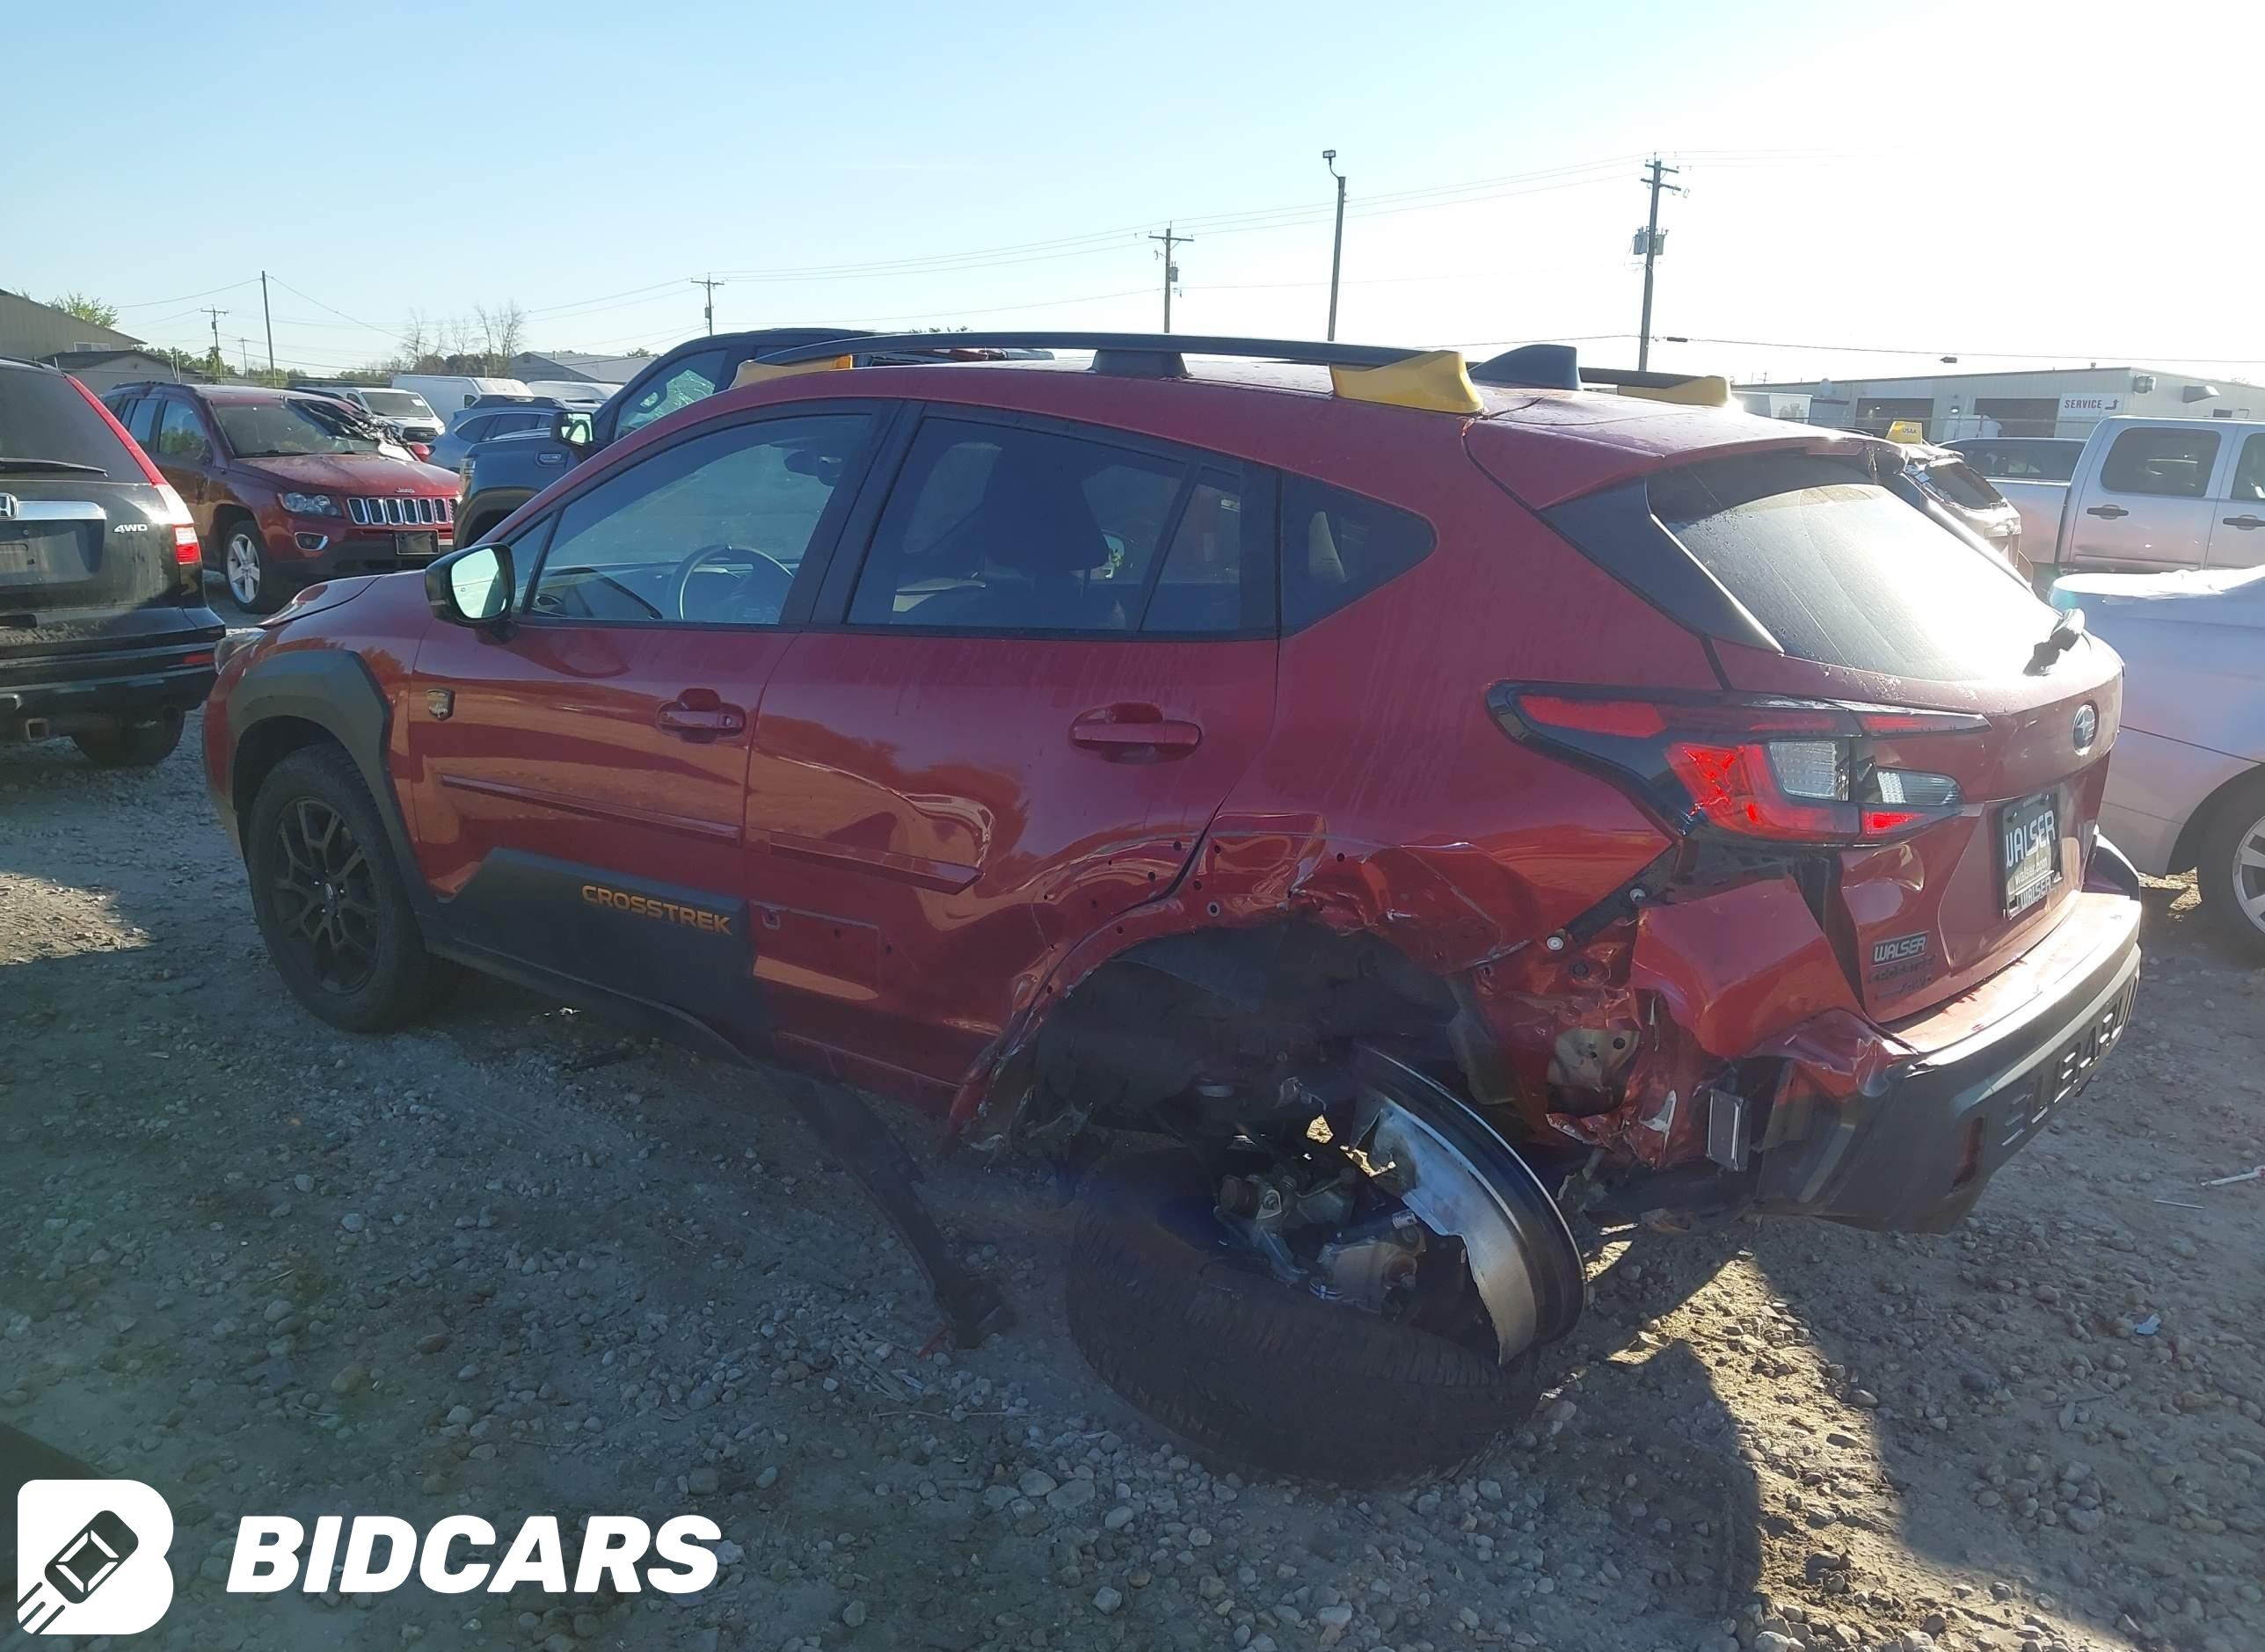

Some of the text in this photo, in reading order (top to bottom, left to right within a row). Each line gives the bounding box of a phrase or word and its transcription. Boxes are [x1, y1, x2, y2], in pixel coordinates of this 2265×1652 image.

[2065, 399, 2102, 410] SERVICE
[114, 523, 149, 534] 4WD
[2014, 857, 2049, 884] walser.com
[2021, 877, 2051, 908] WALSER
[582, 884, 732, 936] CROSSTREK
[1874, 936, 1926, 962] WALSER
